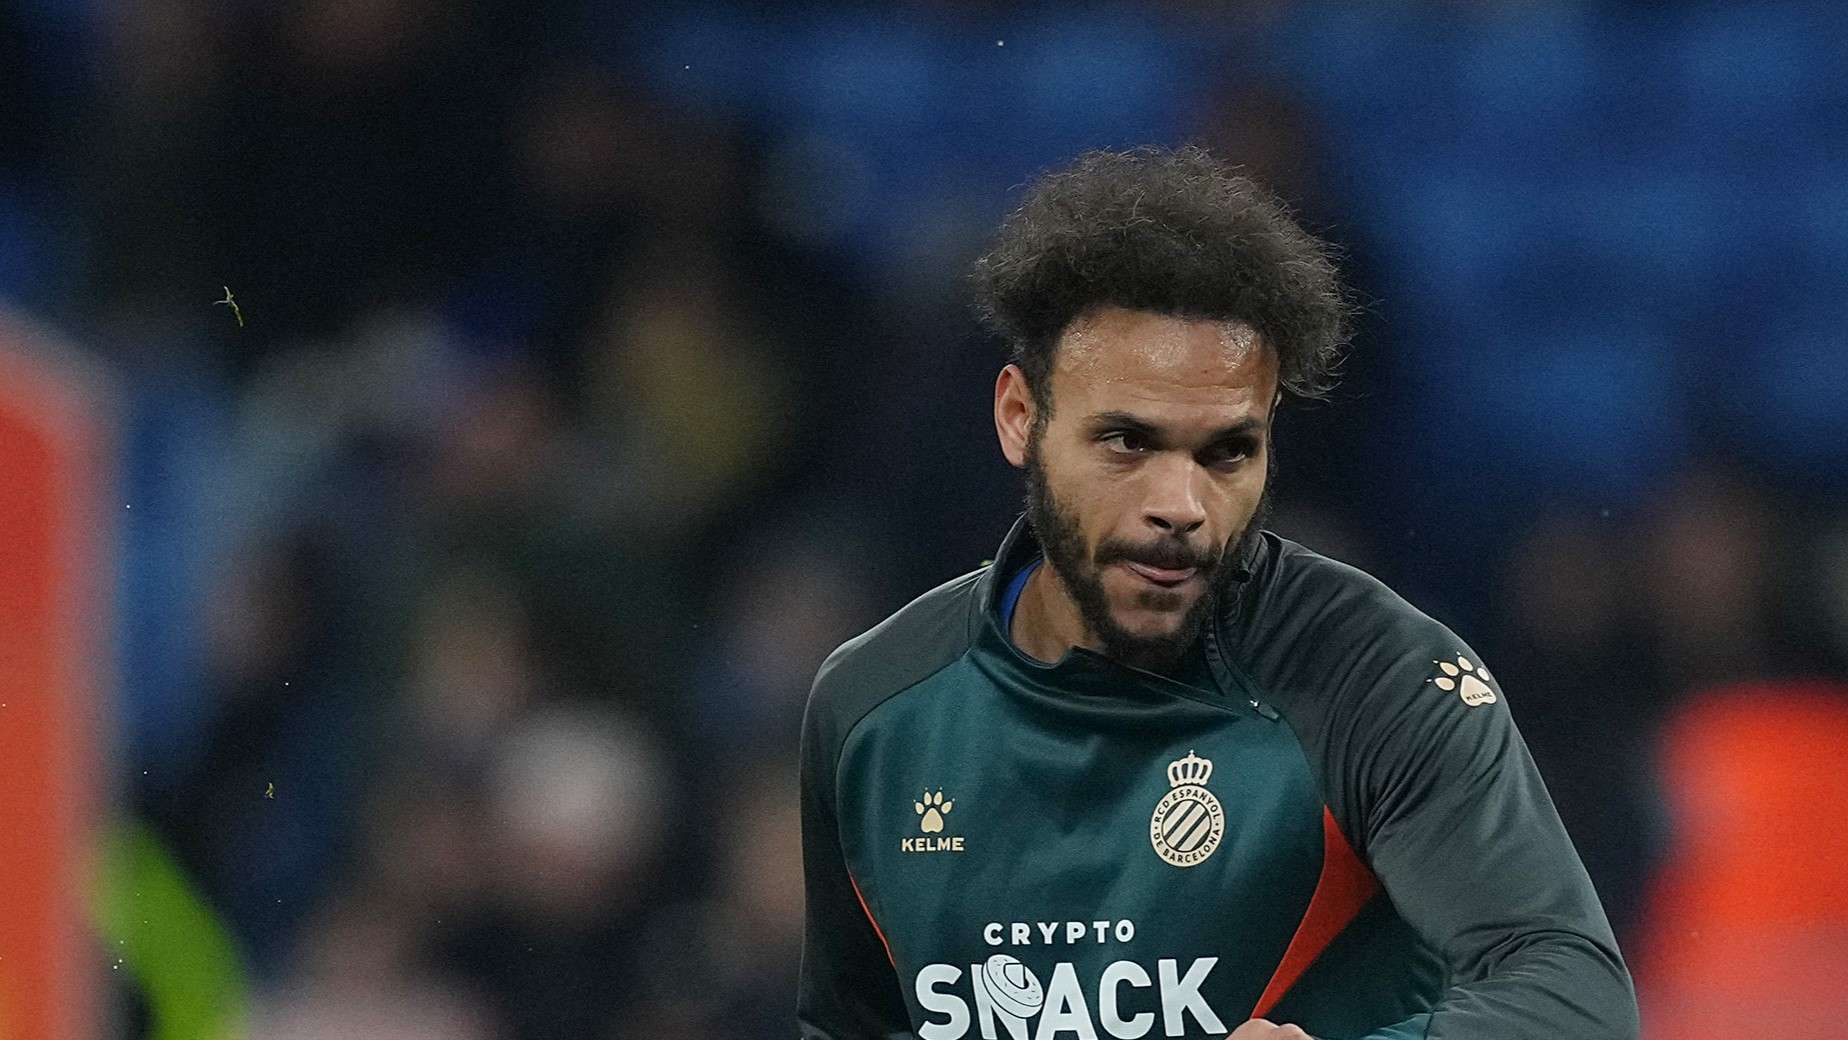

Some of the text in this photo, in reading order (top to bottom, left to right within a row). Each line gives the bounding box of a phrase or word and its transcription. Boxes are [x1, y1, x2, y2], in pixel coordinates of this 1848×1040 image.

[1154, 789, 1221, 823] RCD ESPANYOL
[901, 837, 965, 852] KELME
[1154, 829, 1221, 863] DE BARCELONA
[984, 919, 1135, 946] CRYPTO
